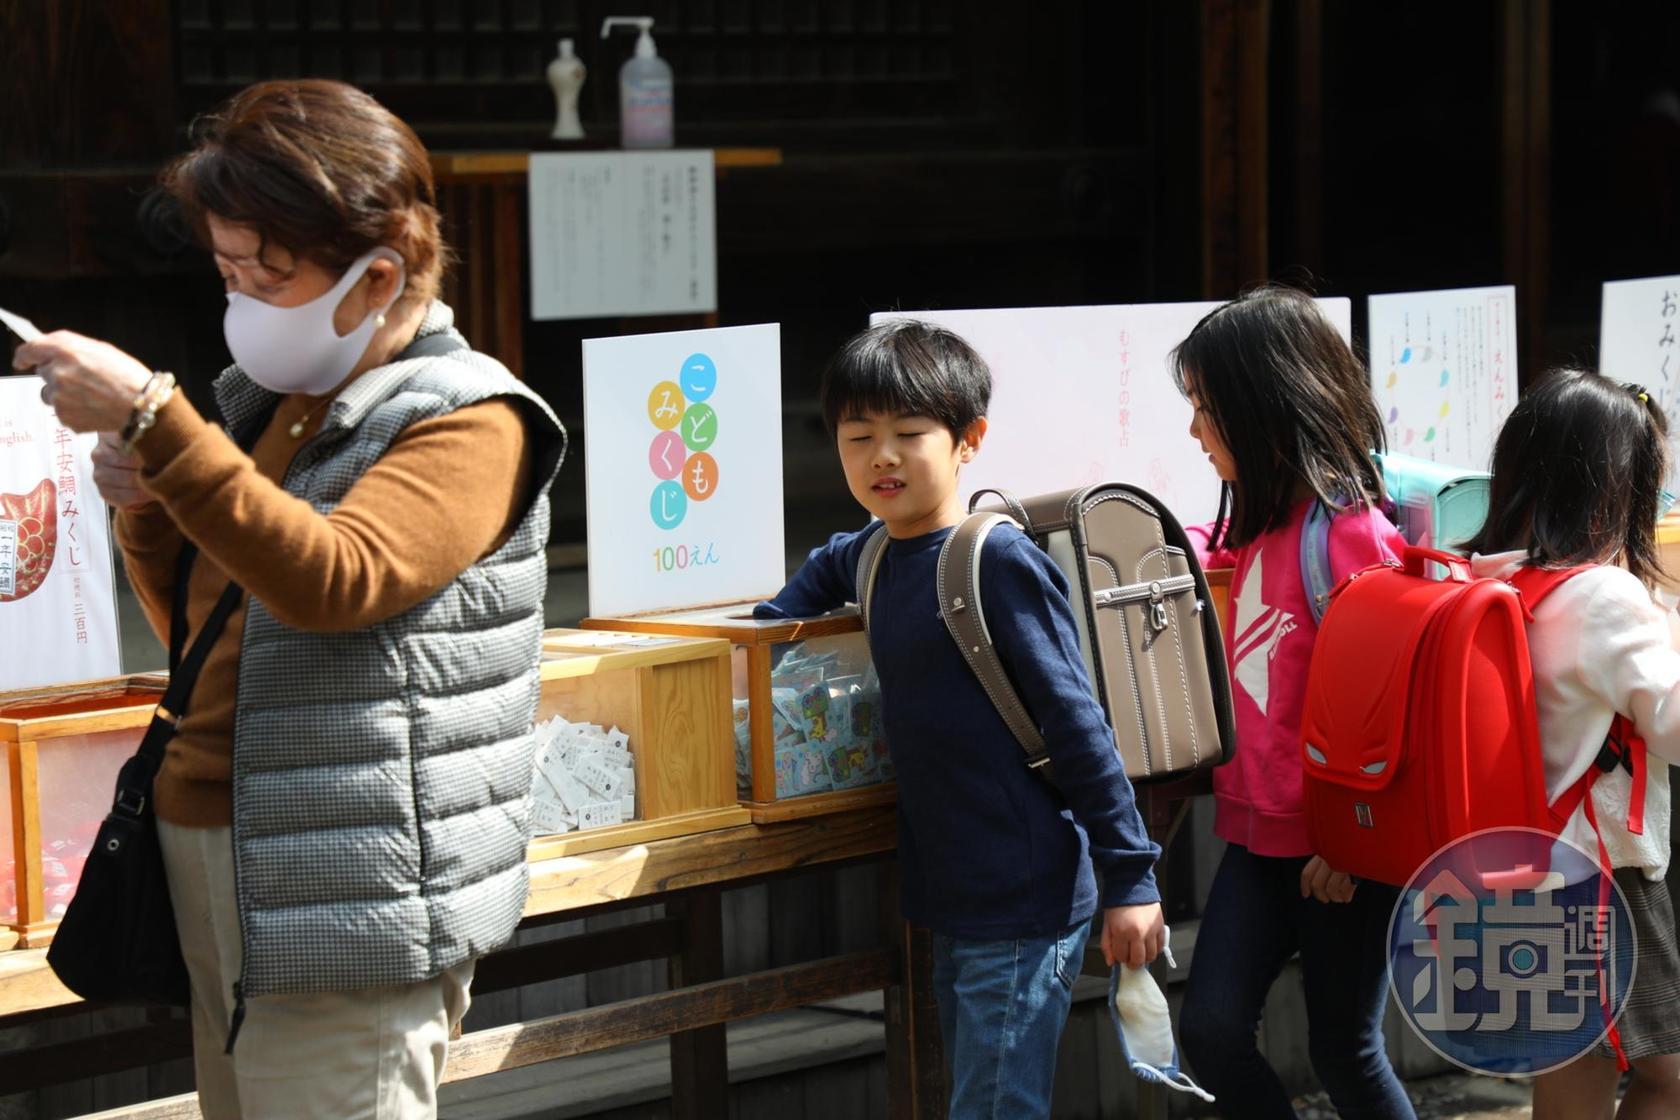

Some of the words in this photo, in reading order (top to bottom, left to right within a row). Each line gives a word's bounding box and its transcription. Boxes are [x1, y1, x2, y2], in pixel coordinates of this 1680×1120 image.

[51, 412, 80, 566] 年安鯛みくじ
[653, 387, 680, 524] みくじ
[688, 363, 713, 496] こども
[73, 602, 88, 644] 三百円
[653, 543, 719, 571] 100えん
